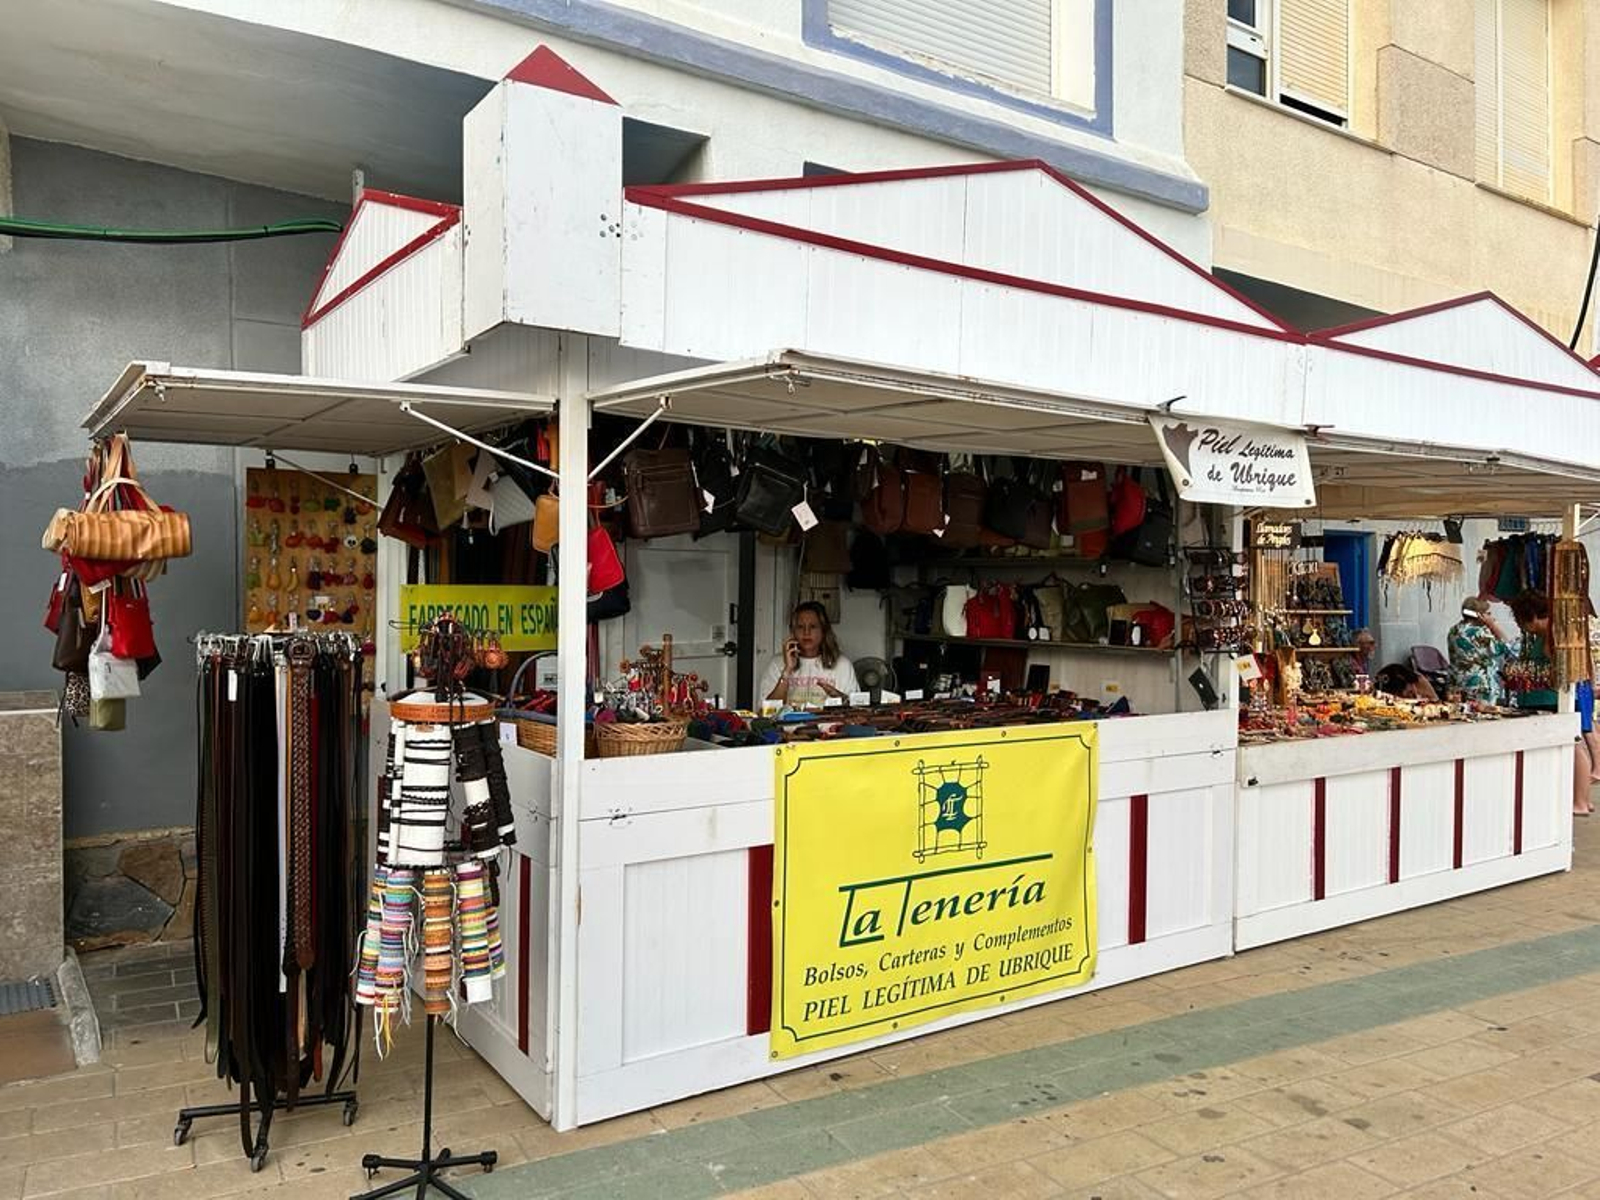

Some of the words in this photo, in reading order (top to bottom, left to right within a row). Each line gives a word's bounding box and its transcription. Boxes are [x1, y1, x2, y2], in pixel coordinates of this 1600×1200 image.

[1198, 428, 1242, 455] Piel
[1207, 464, 1223, 482] de
[1231, 462, 1297, 492] Ubrique
[498, 603, 513, 635] EN
[896, 868, 1047, 936] Tenería
[804, 962, 869, 987] Bolsos,
[878, 943, 947, 973] Carteras
[954, 941, 965, 961] y
[973, 914, 1073, 951] Complementos
[803, 993, 851, 1022] PIEL
[862, 970, 956, 1010] LEGÍTIMA
[966, 963, 991, 986] DE
[999, 942, 1074, 978] UBRIQUE
